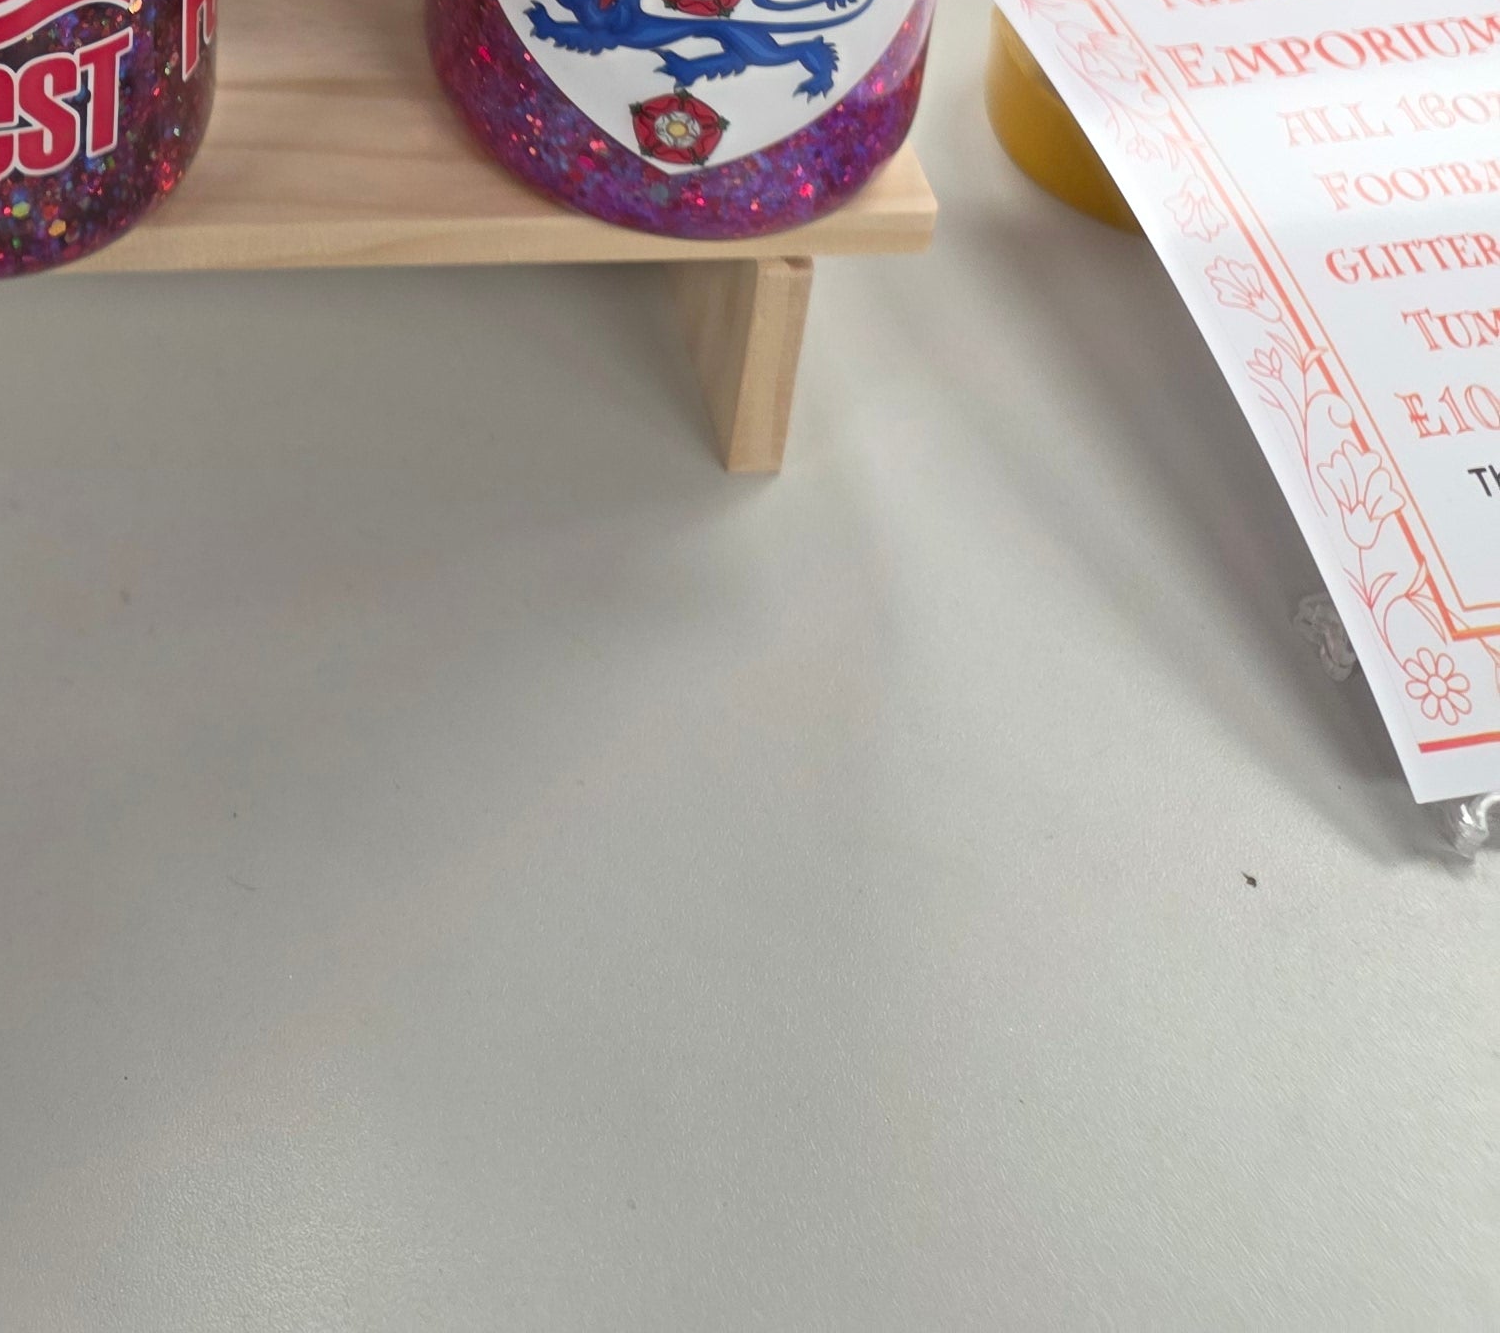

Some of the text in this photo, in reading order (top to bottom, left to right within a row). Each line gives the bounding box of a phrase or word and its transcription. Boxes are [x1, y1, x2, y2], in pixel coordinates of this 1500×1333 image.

[1160, 15, 1500, 90] EMPORIUM
[1276, 101, 1395, 148] ALL
[1313, 158, 1500, 212] FOOTBA
[1325, 232, 1500, 284] GLITTER
